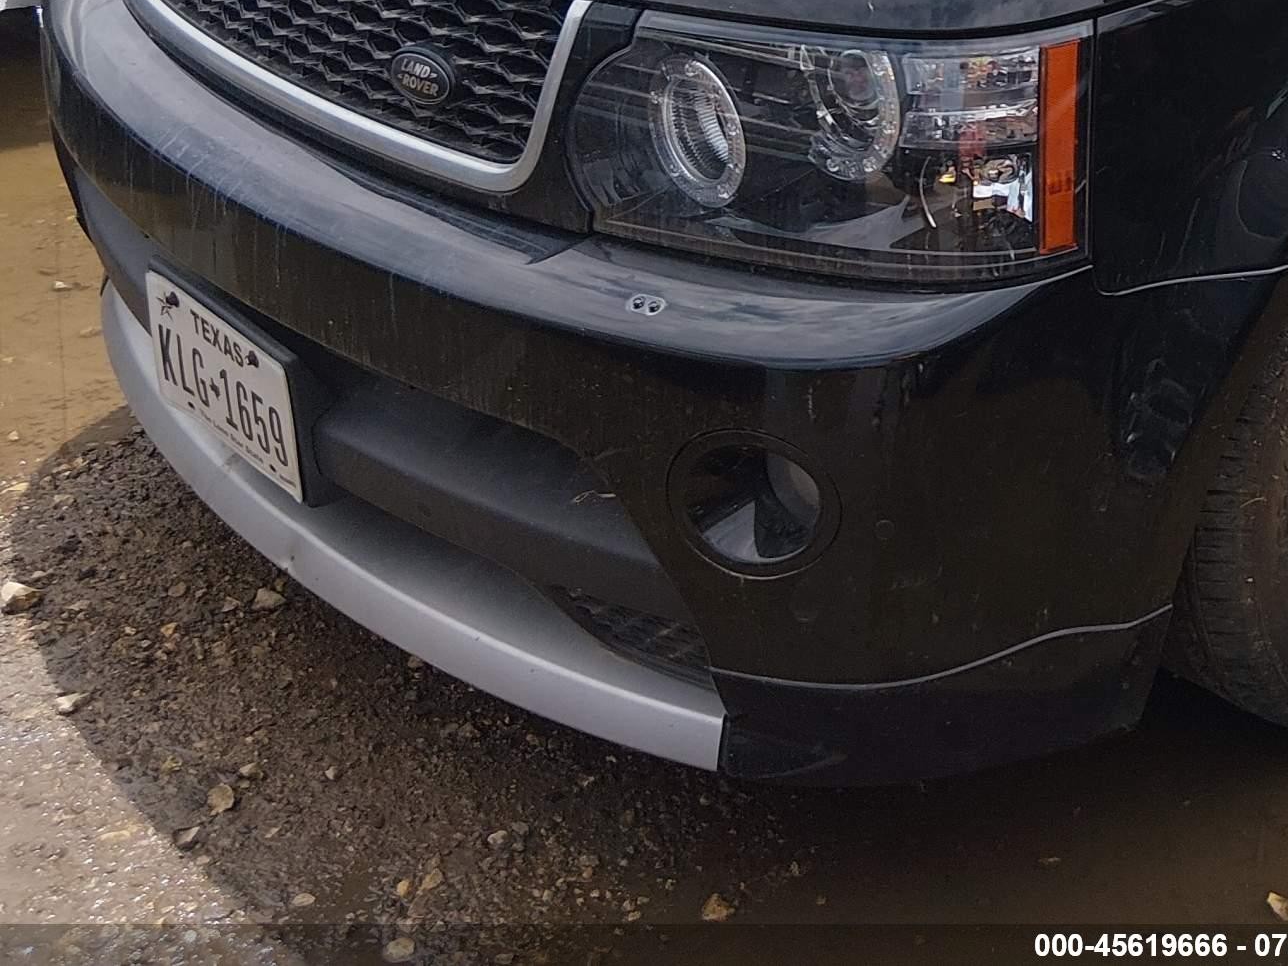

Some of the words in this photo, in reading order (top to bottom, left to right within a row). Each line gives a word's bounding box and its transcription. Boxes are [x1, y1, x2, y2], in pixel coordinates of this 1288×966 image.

[401, 58, 431, 78] LAND
[402, 74, 440, 96] ROVER
[190, 308, 244, 368] TEXAS
